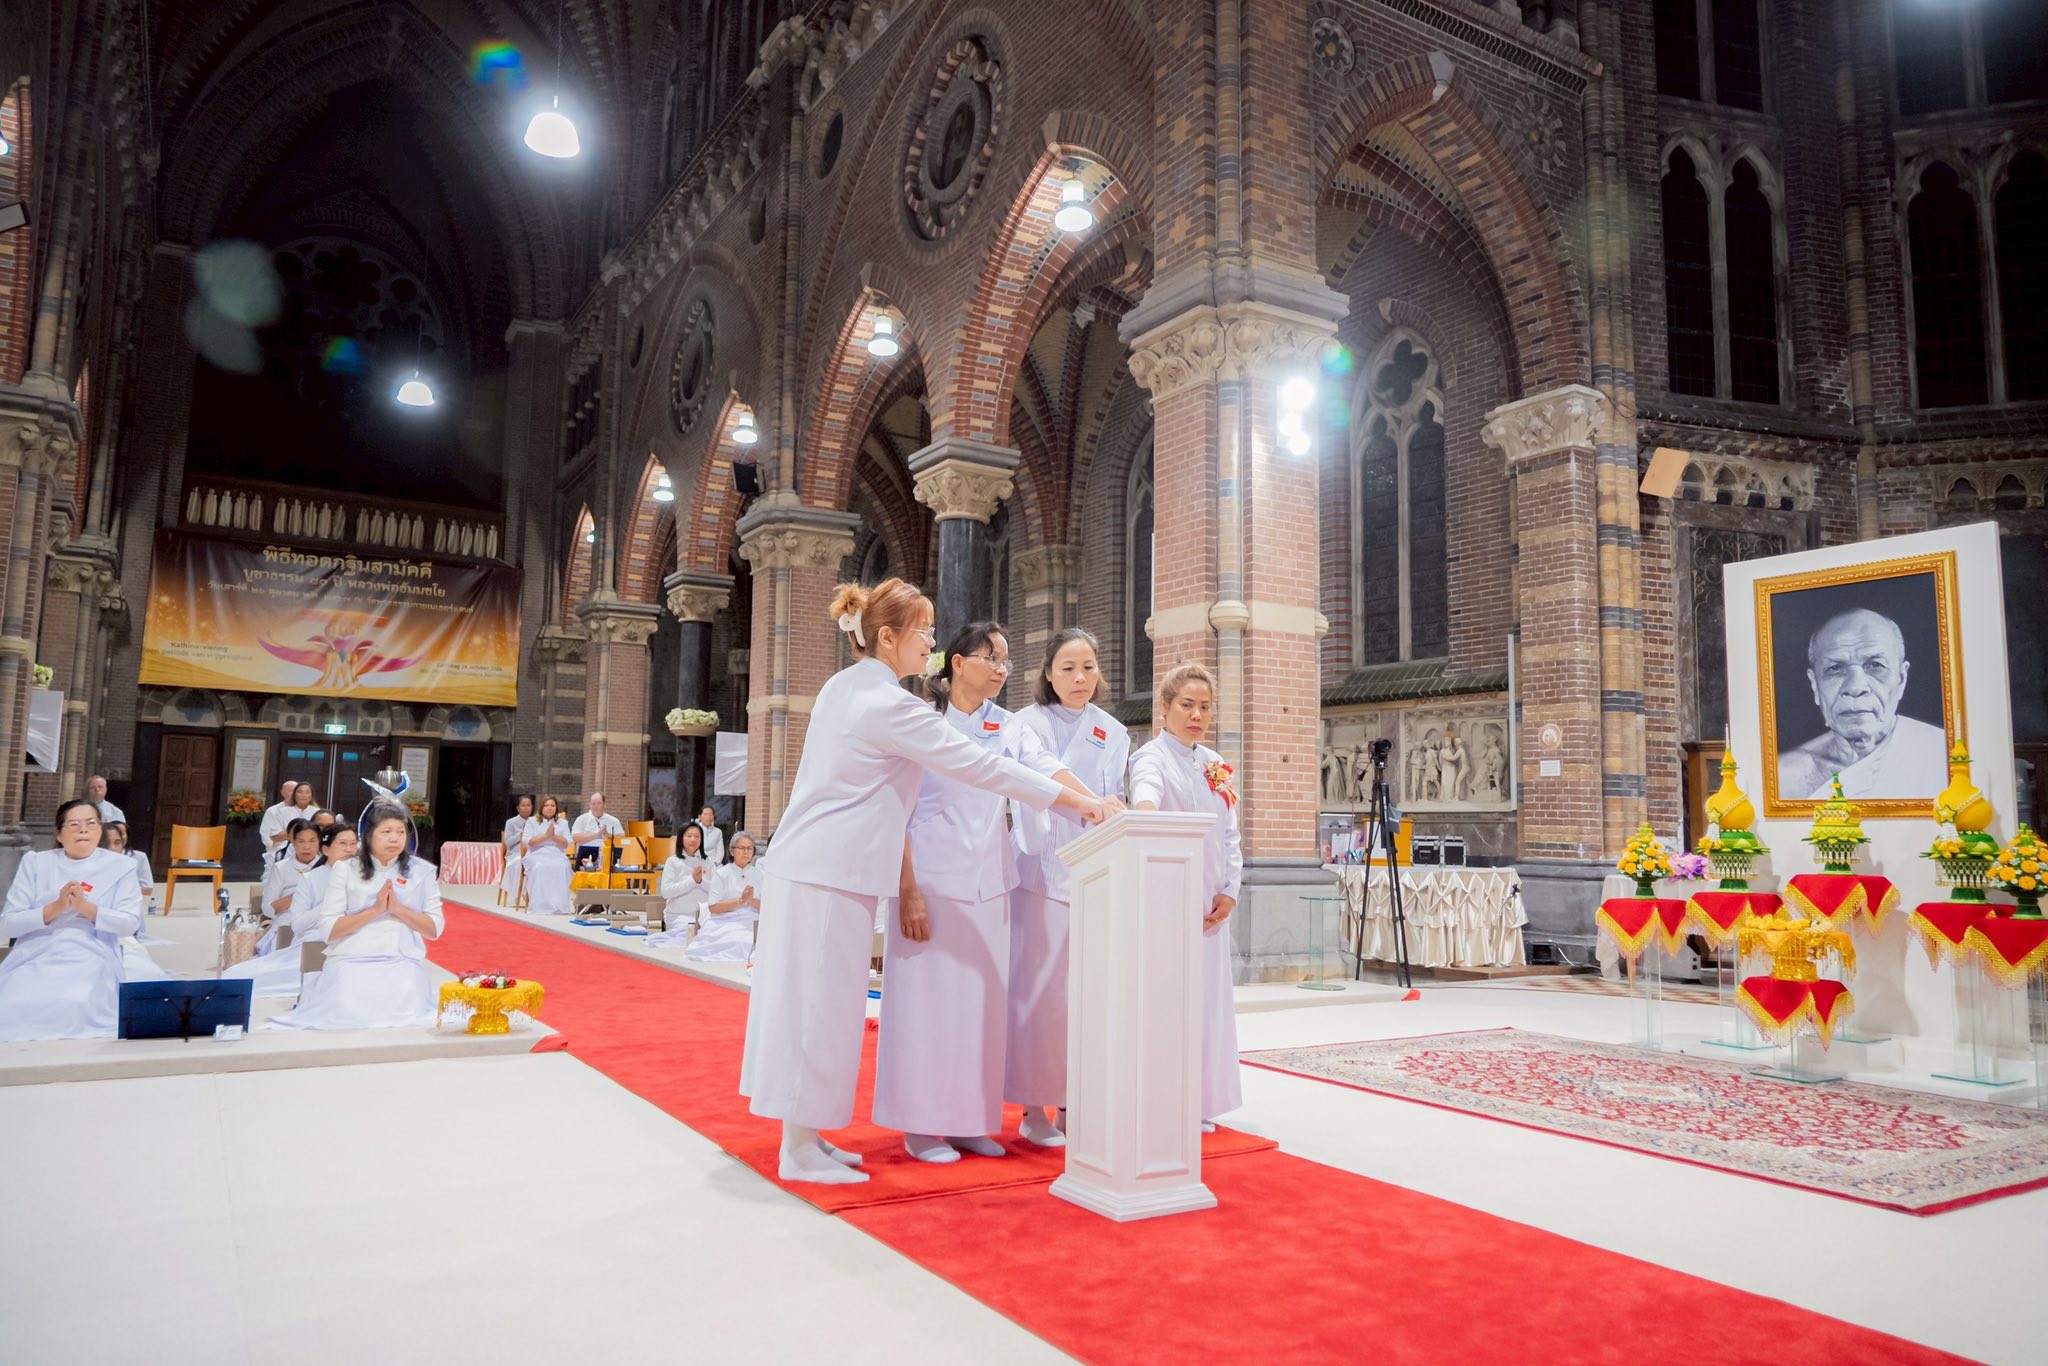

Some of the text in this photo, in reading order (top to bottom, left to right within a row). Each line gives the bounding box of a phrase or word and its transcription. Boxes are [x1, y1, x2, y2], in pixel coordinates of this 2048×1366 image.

[263, 545, 432, 579] พิธีทอดกฐินสามัคคี
[243, 568, 304, 583] บูชาธรรม
[347, 578, 446, 598] หลวงพ่อธัมมชโย
